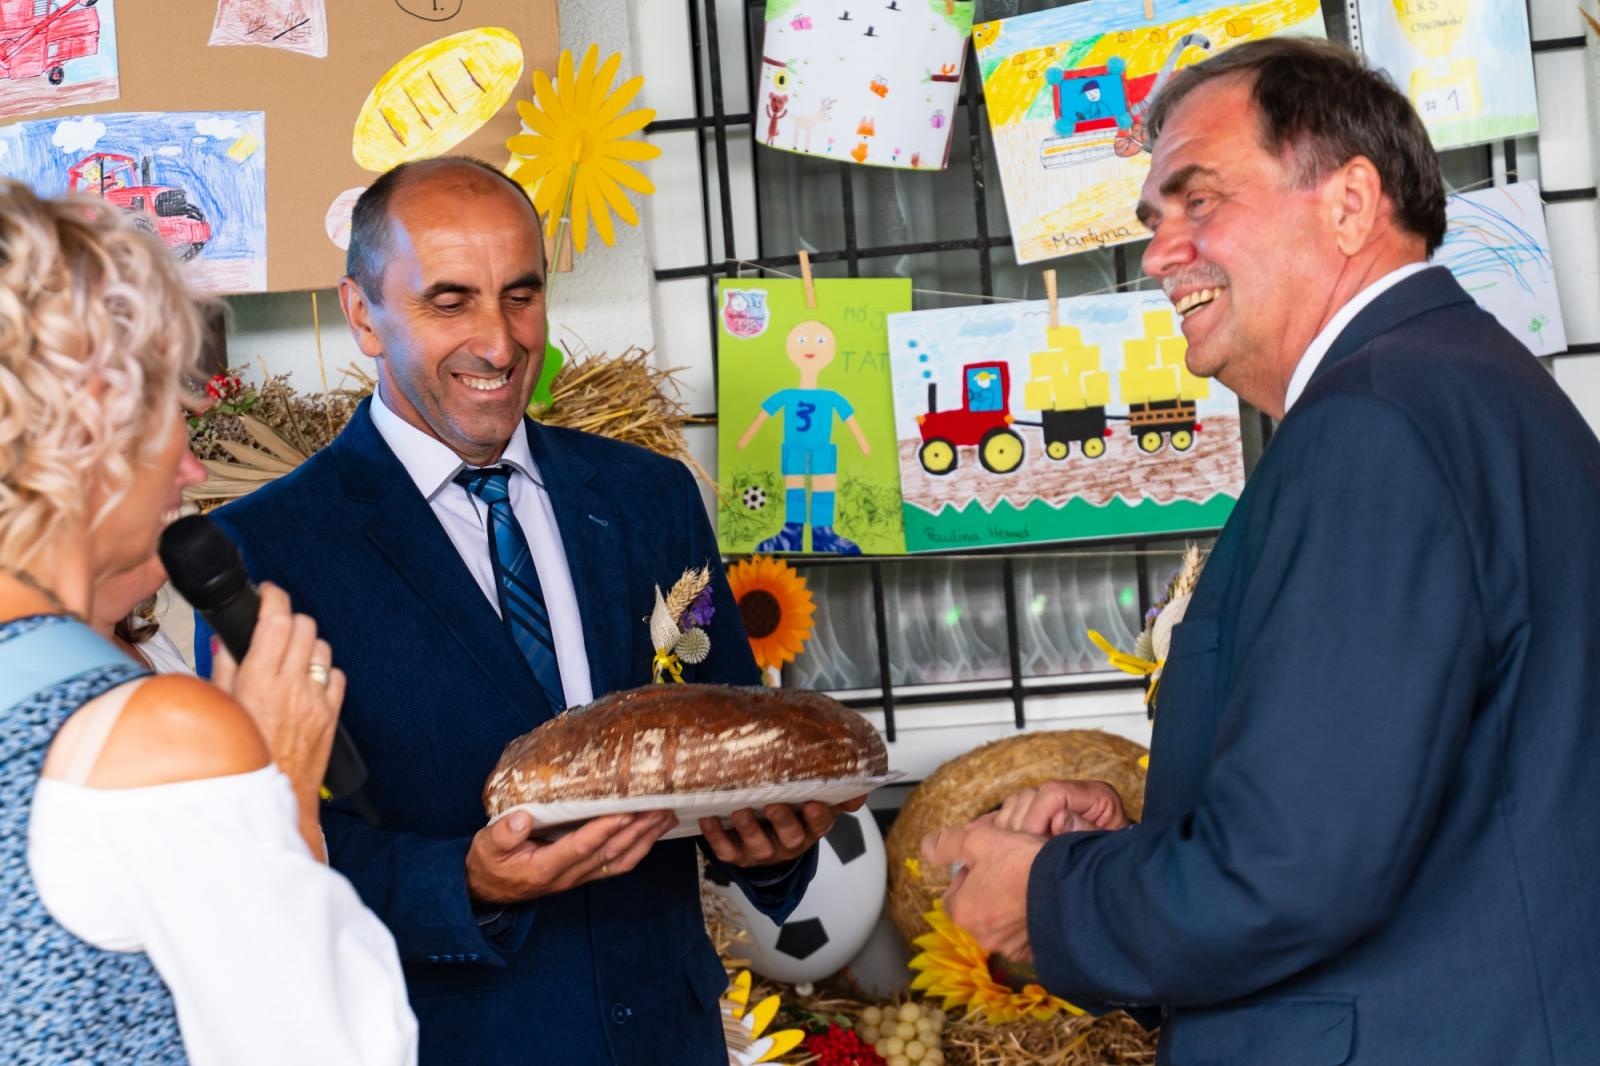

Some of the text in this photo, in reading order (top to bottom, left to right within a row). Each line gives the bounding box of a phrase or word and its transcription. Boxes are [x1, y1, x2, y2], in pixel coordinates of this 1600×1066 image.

[1446, 88, 1460, 113] 1
[1051, 225, 1133, 249] Martyna
[843, 304, 885, 331] MÓJ
[796, 400, 817, 432] 3
[923, 526, 981, 543] Paulina
